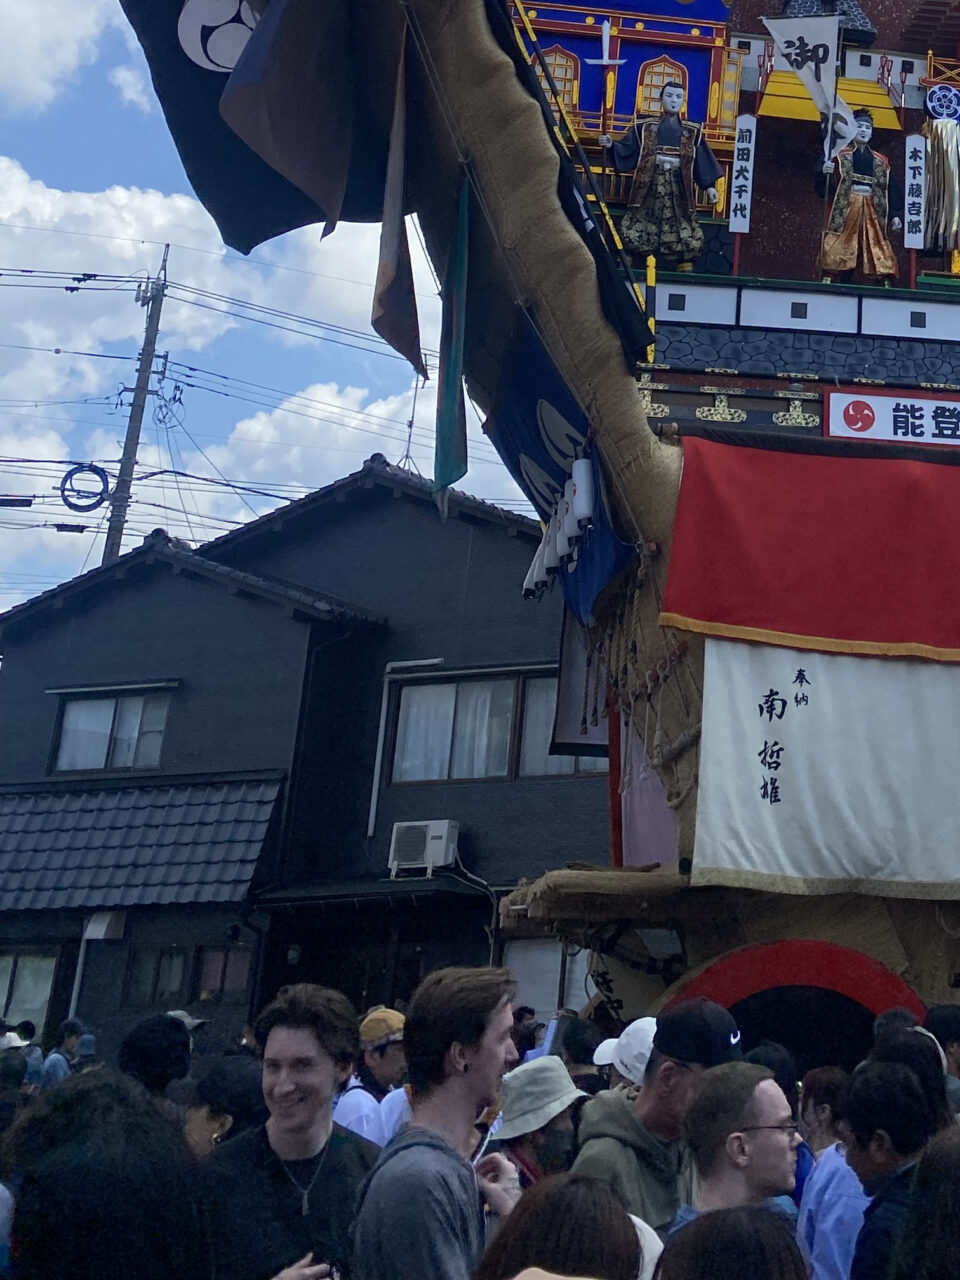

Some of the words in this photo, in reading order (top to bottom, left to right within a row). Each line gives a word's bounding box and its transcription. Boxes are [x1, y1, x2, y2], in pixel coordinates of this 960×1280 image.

[732, 128, 753, 219] 前田犬千代
[907, 147, 923, 234] 木下藤吉郎
[792, 668, 811, 707] 奉納
